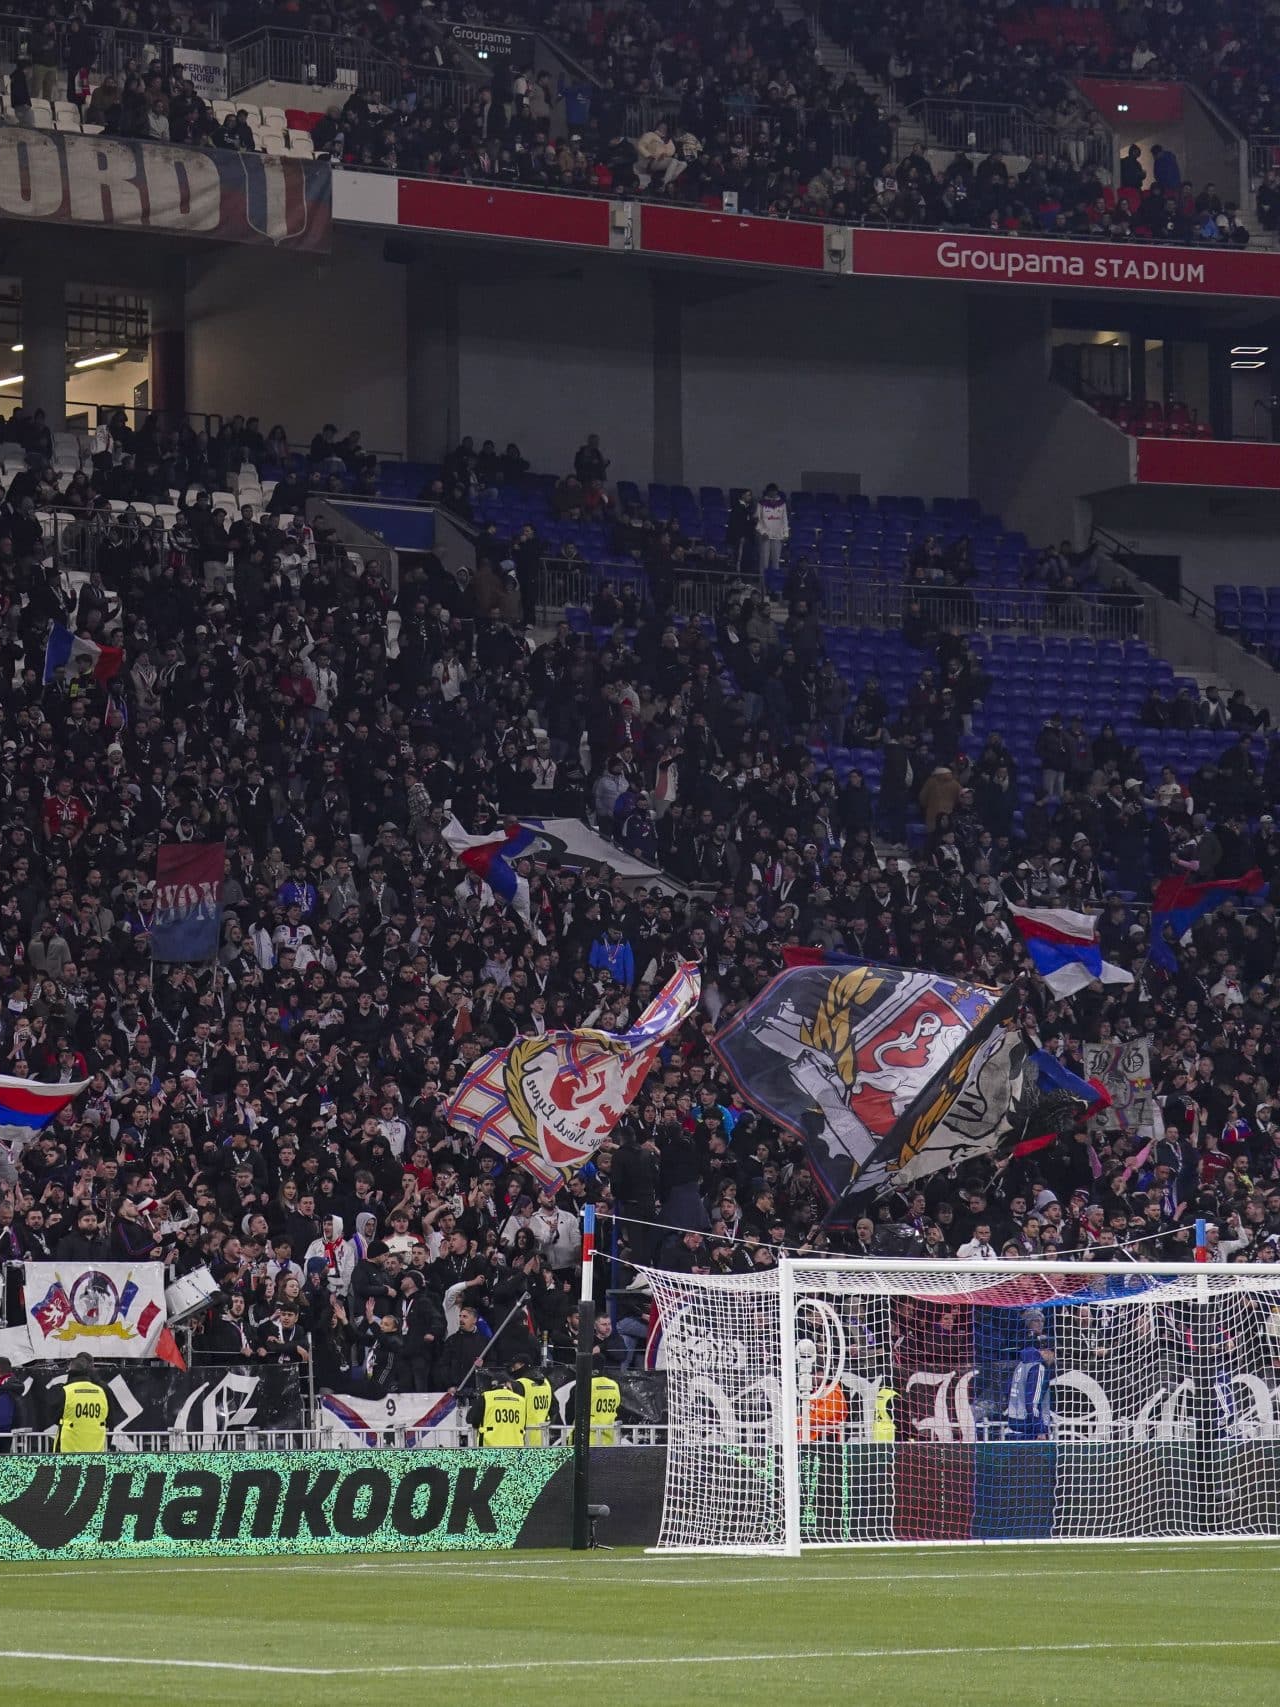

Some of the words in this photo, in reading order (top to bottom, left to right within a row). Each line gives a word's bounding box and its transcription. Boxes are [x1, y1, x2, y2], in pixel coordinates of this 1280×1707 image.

[452, 25, 511, 44] Groupama
[474, 43, 512, 54] STADIUM
[937, 241, 1084, 277] Groupama
[1094, 258, 1205, 283] STADIUM
[75, 1402, 101, 1419] 0409
[386, 1398, 396, 1417] 9
[596, 1398, 616, 1413] 0352
[495, 1408, 520, 1424] 0306
